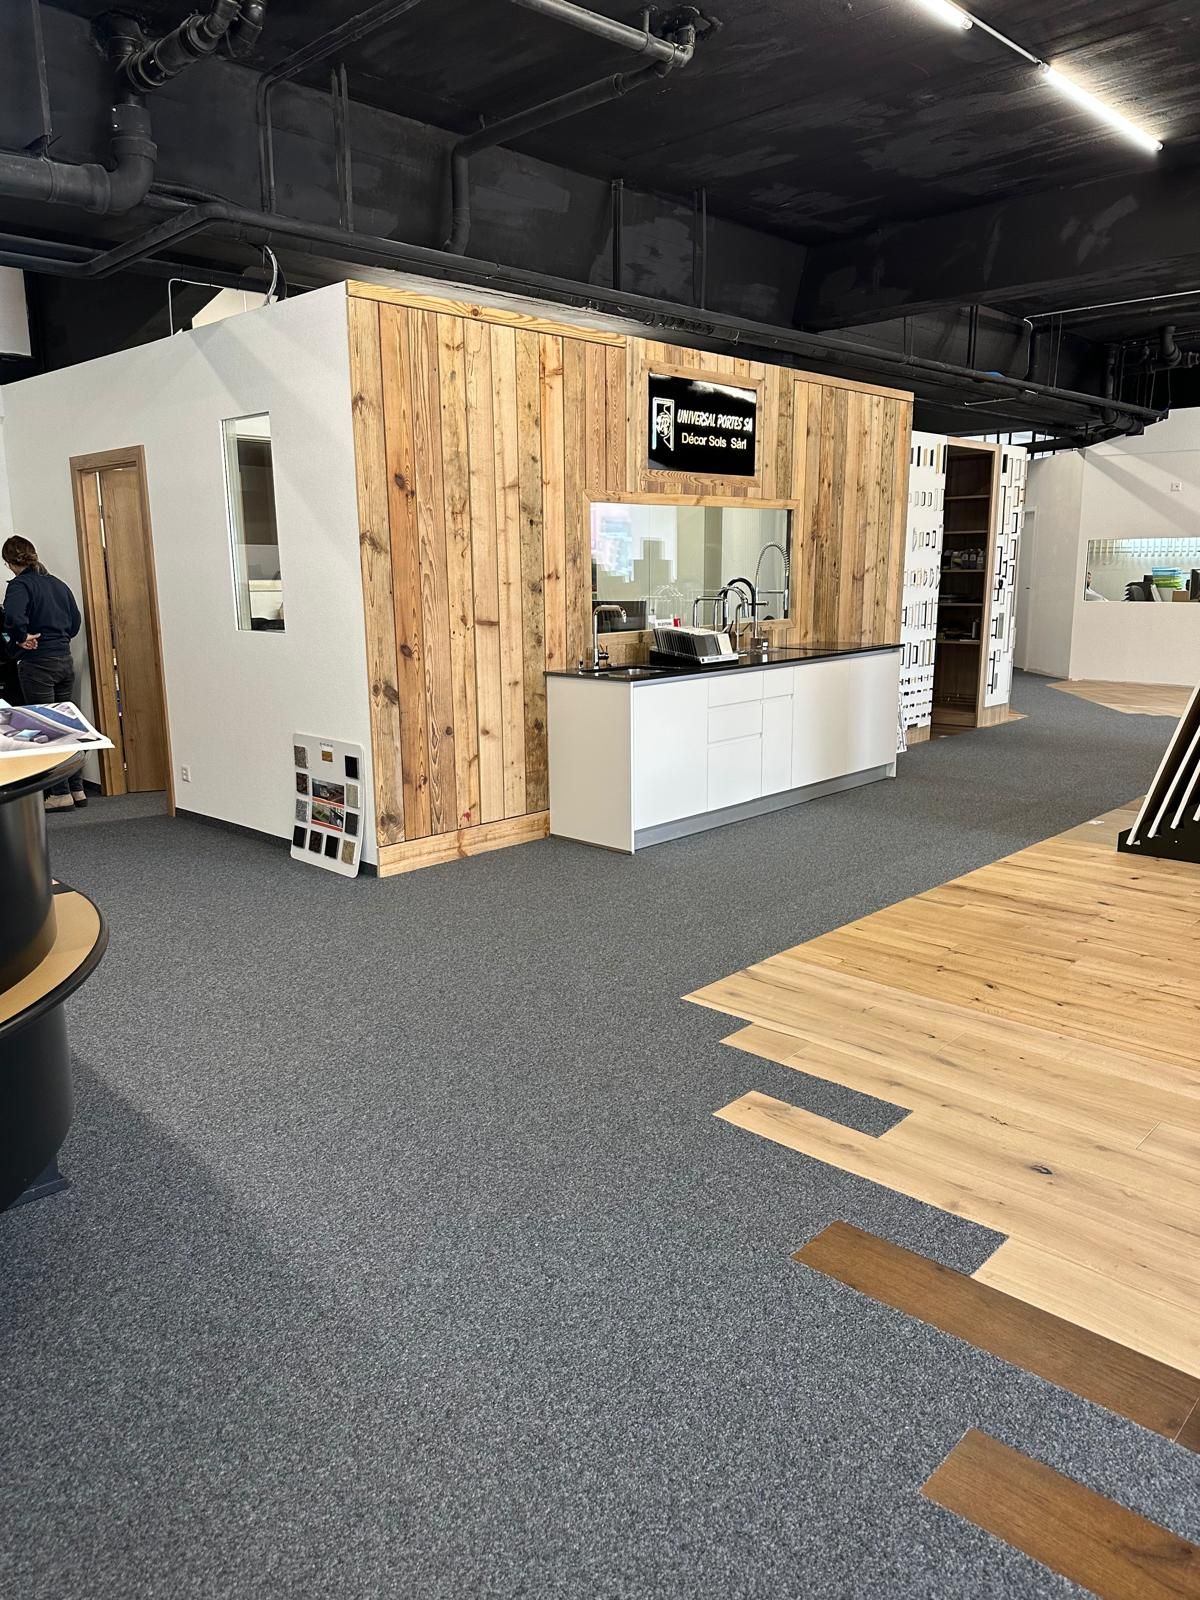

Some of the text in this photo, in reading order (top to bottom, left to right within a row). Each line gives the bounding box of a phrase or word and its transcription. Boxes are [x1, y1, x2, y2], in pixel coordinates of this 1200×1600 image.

[677, 409, 753, 432] UNIVERSAL PORTES SA
[682, 432, 707, 445] Décor
[709, 435, 726, 447] Sols
